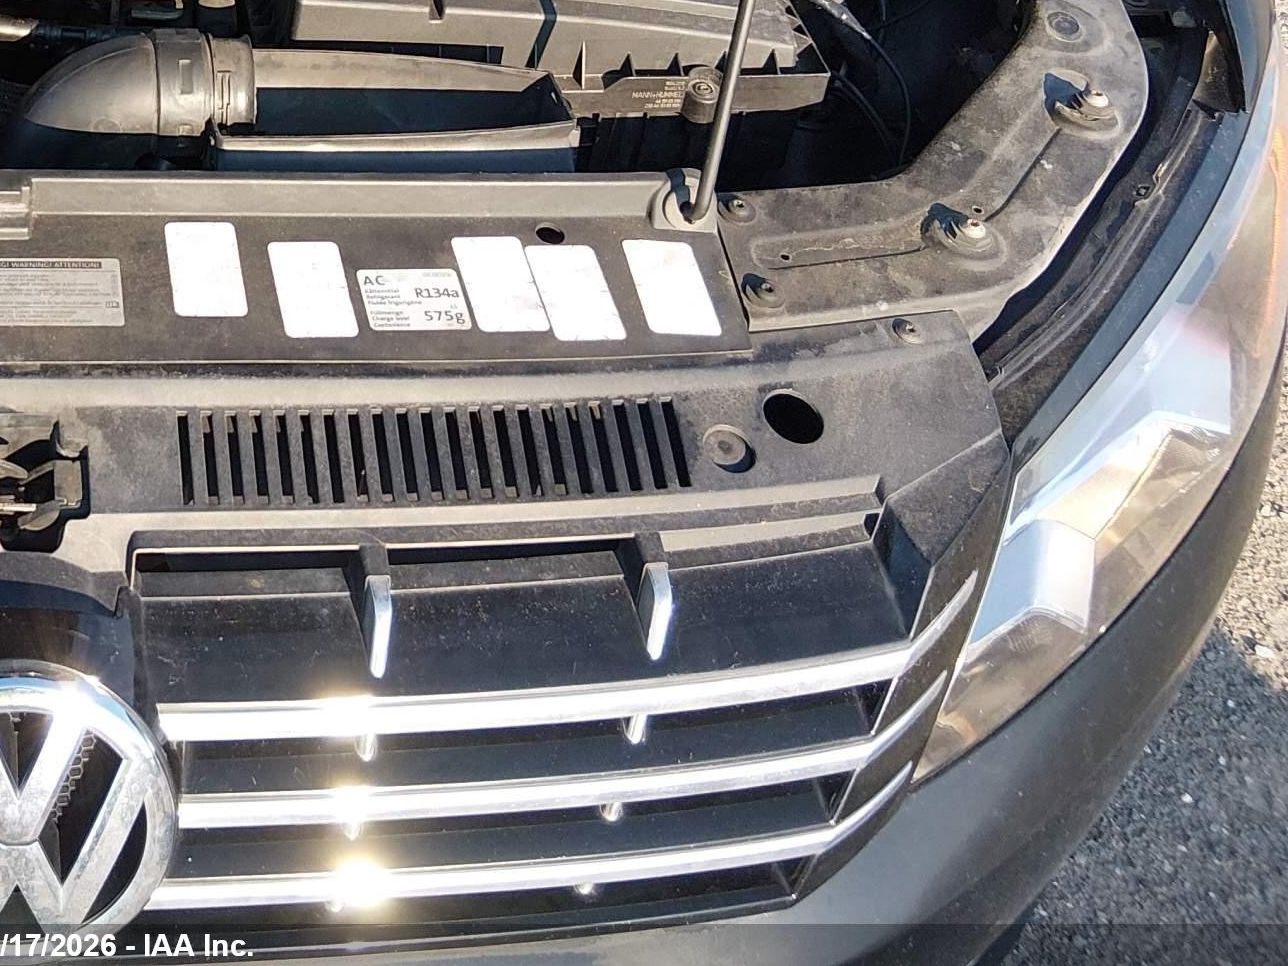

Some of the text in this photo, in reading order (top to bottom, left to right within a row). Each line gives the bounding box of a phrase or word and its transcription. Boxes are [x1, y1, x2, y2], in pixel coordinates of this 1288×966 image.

[11, 261, 53, 269] WARNING!
[363, 275, 386, 286] AC
[414, 287, 460, 298] R134a
[423, 310, 466, 325] 575g
